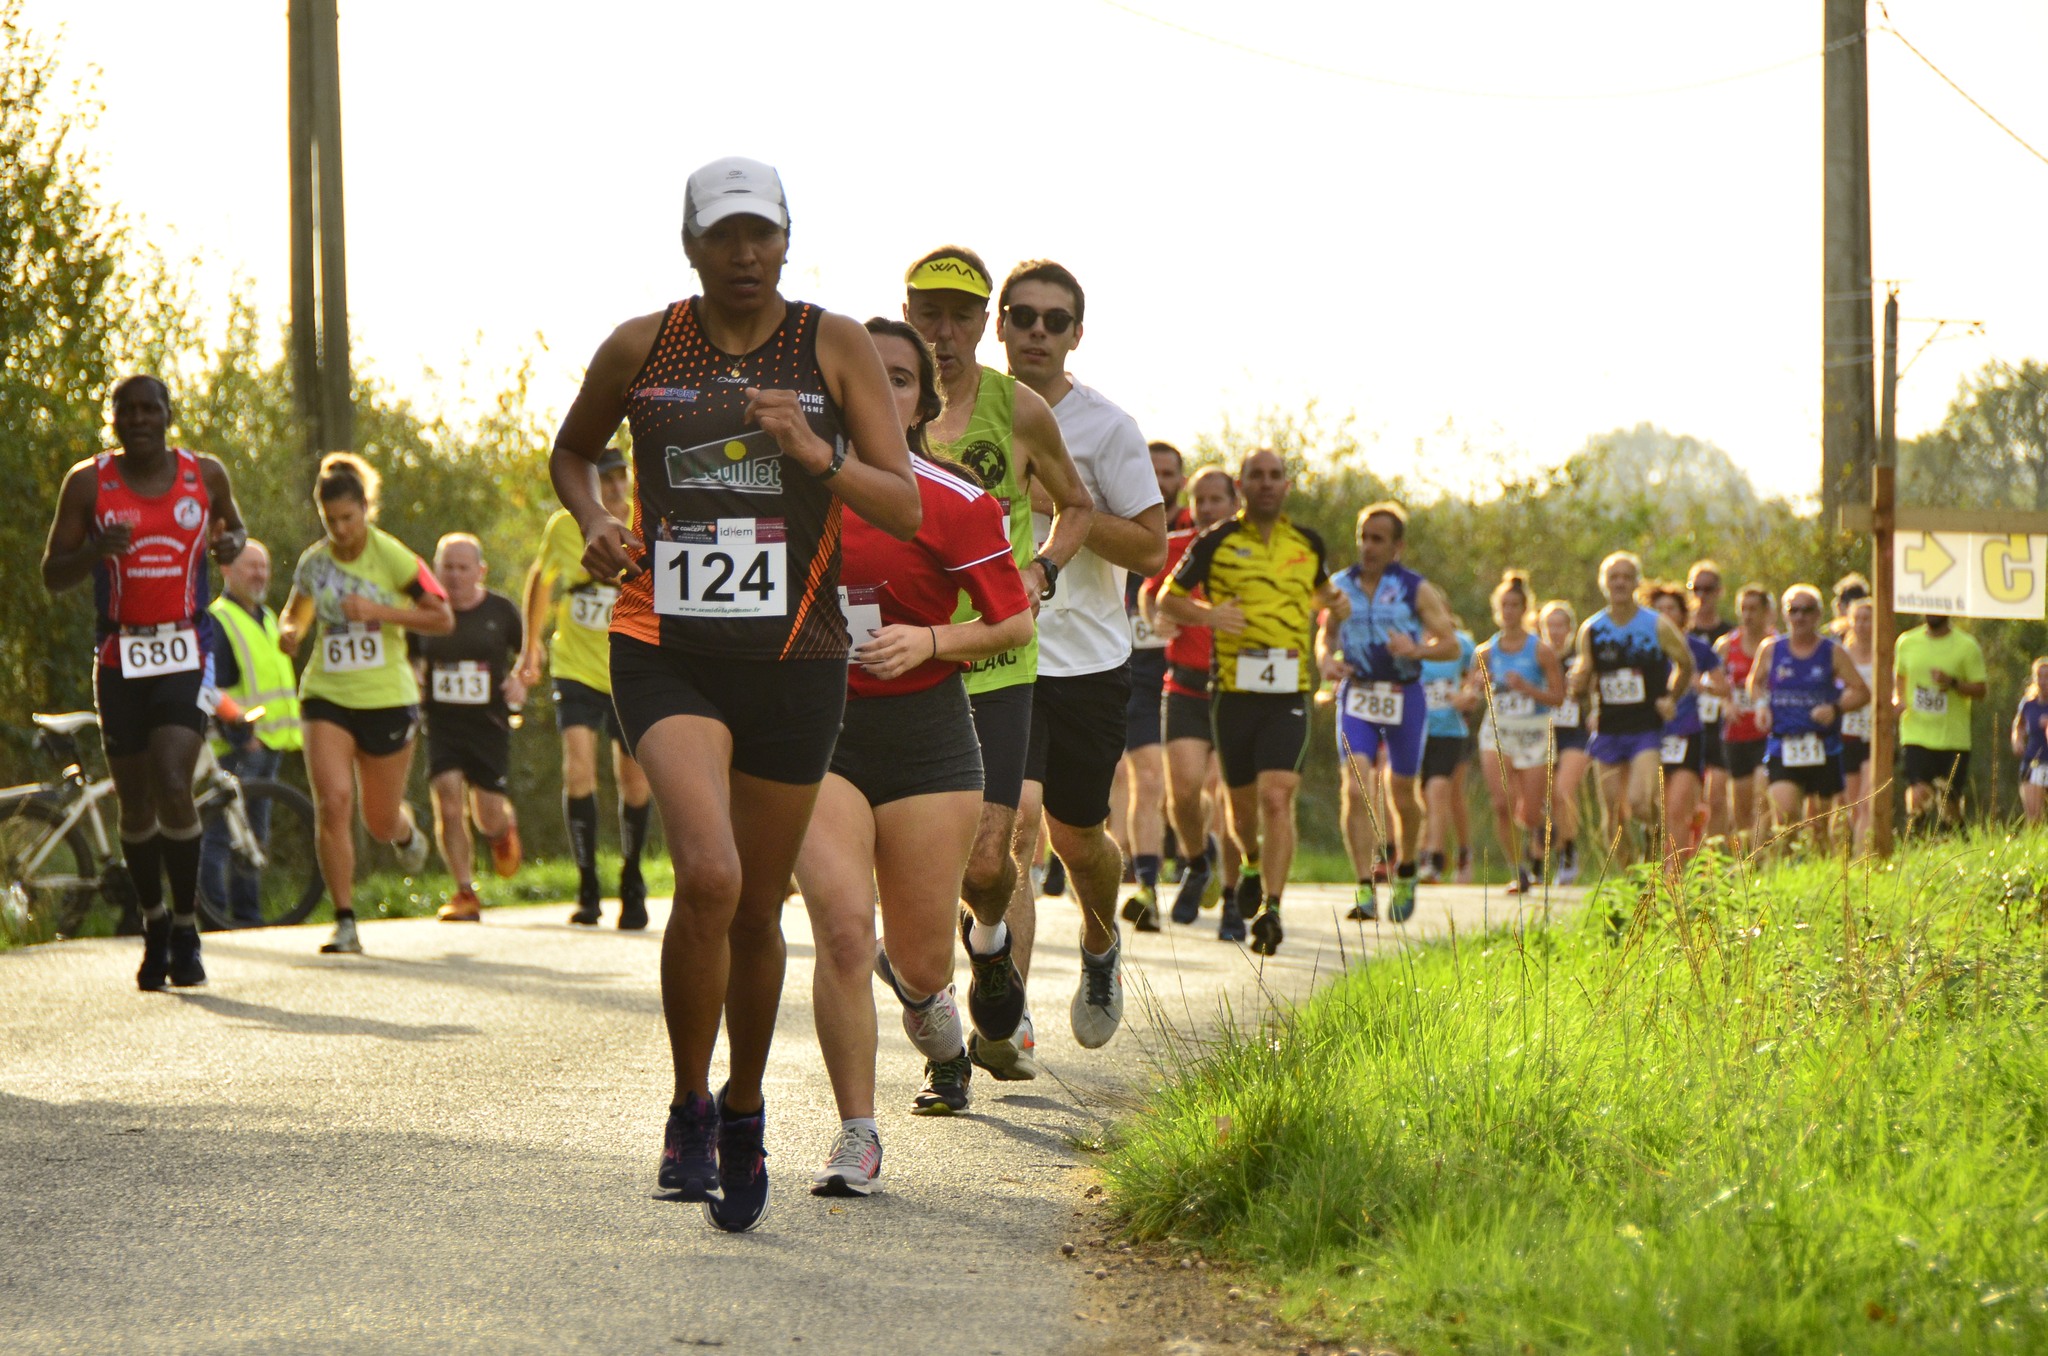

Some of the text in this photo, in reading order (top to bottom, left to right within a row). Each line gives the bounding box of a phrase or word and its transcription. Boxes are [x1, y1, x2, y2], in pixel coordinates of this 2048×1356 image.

[798, 393, 824, 404] ATRE
[668, 550, 775, 602] 124
[128, 637, 188, 668] 680
[328, 637, 376, 663] 619
[438, 675, 483, 698] 413
[1259, 664, 1275, 685] 4
[1353, 692, 1396, 718] 288
